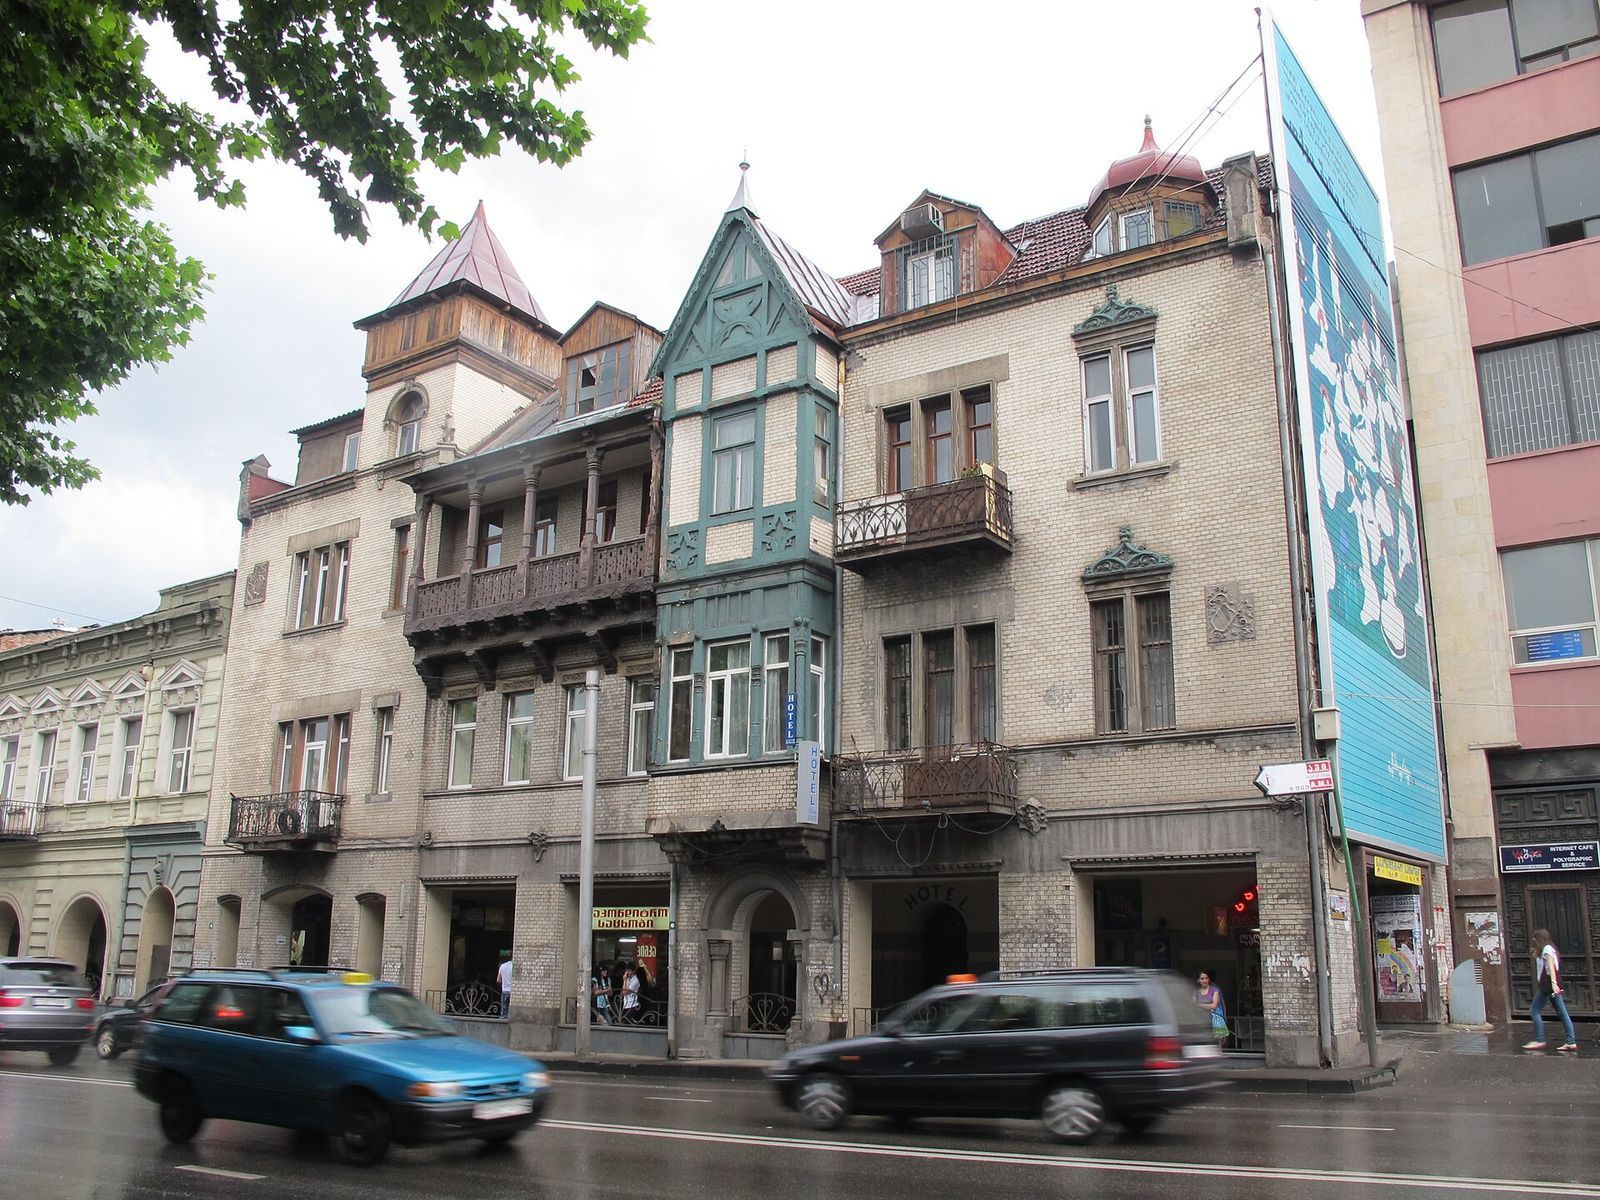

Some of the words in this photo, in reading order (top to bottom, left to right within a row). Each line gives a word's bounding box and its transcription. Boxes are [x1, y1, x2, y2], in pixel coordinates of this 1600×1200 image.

[1310, 780, 1332, 788] A.M.I.
[904, 883, 968, 911] HOTEL
[593, 908, 668, 918] აკონდიტრო
